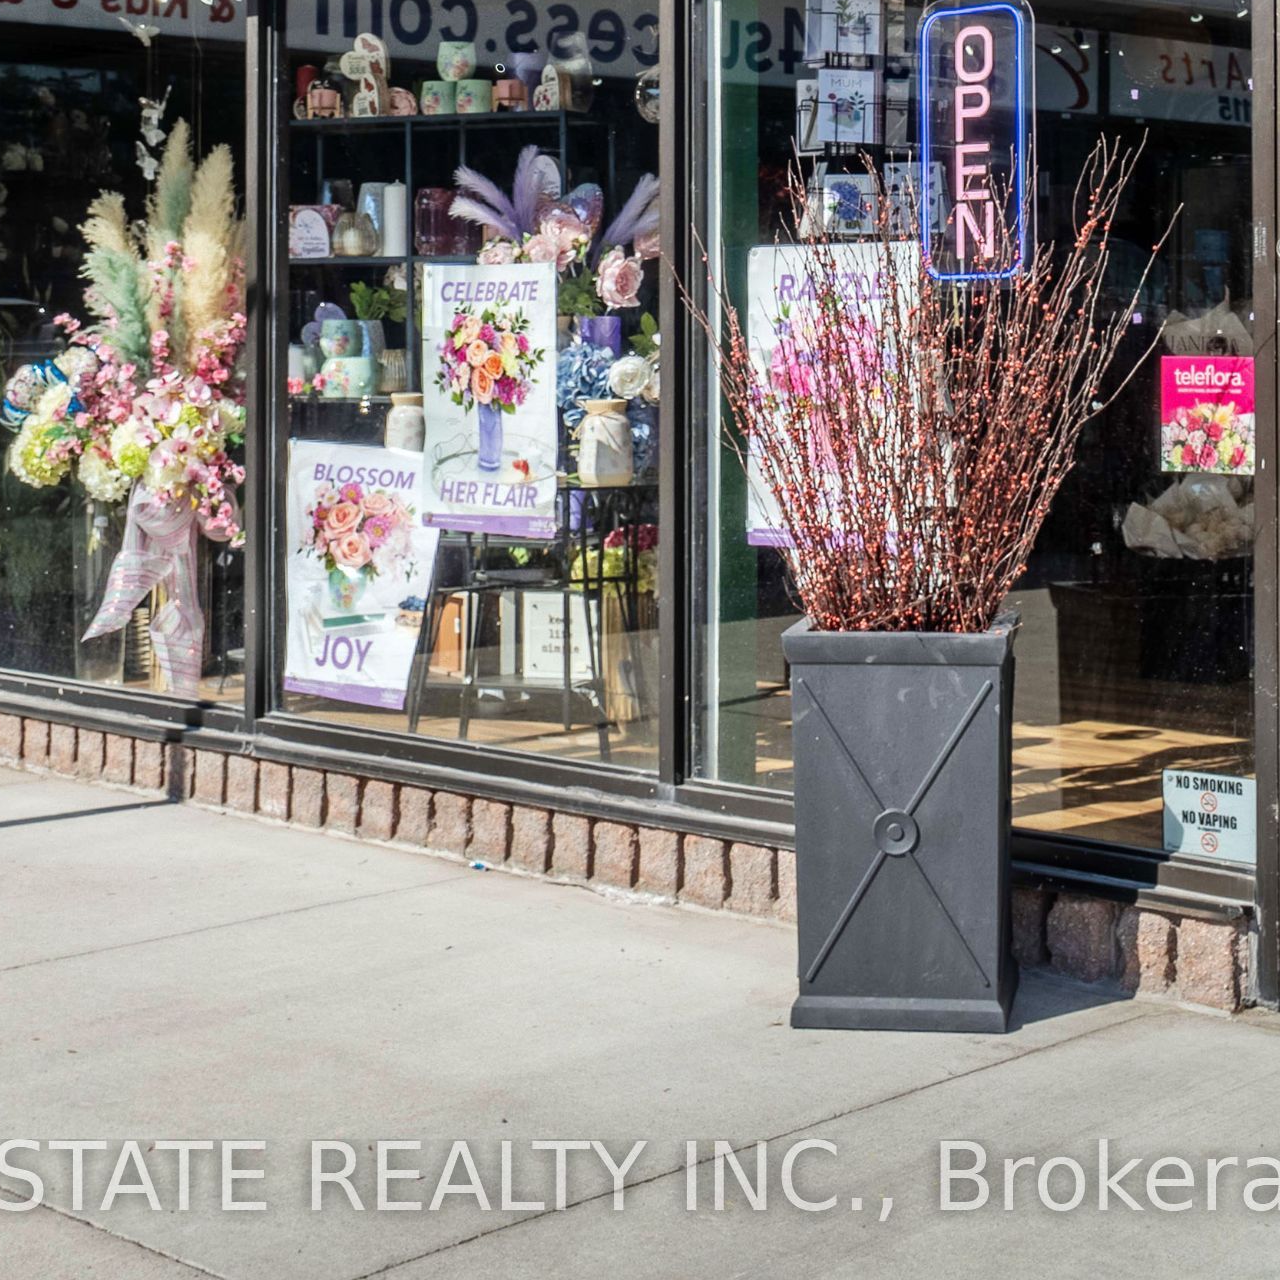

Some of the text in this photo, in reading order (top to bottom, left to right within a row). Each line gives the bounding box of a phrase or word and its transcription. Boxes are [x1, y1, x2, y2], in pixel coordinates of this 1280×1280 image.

[953, 25, 996, 261] OPEN
[440, 279, 540, 304] CELEBRATE
[312, 462, 416, 490] BLOSSOM
[440, 480, 538, 509] HER FLAIR
[315, 635, 373, 673] JOY
[1176, 775, 1243, 796] NO SMOKING
[1182, 810, 1238, 830] NO VAPING
